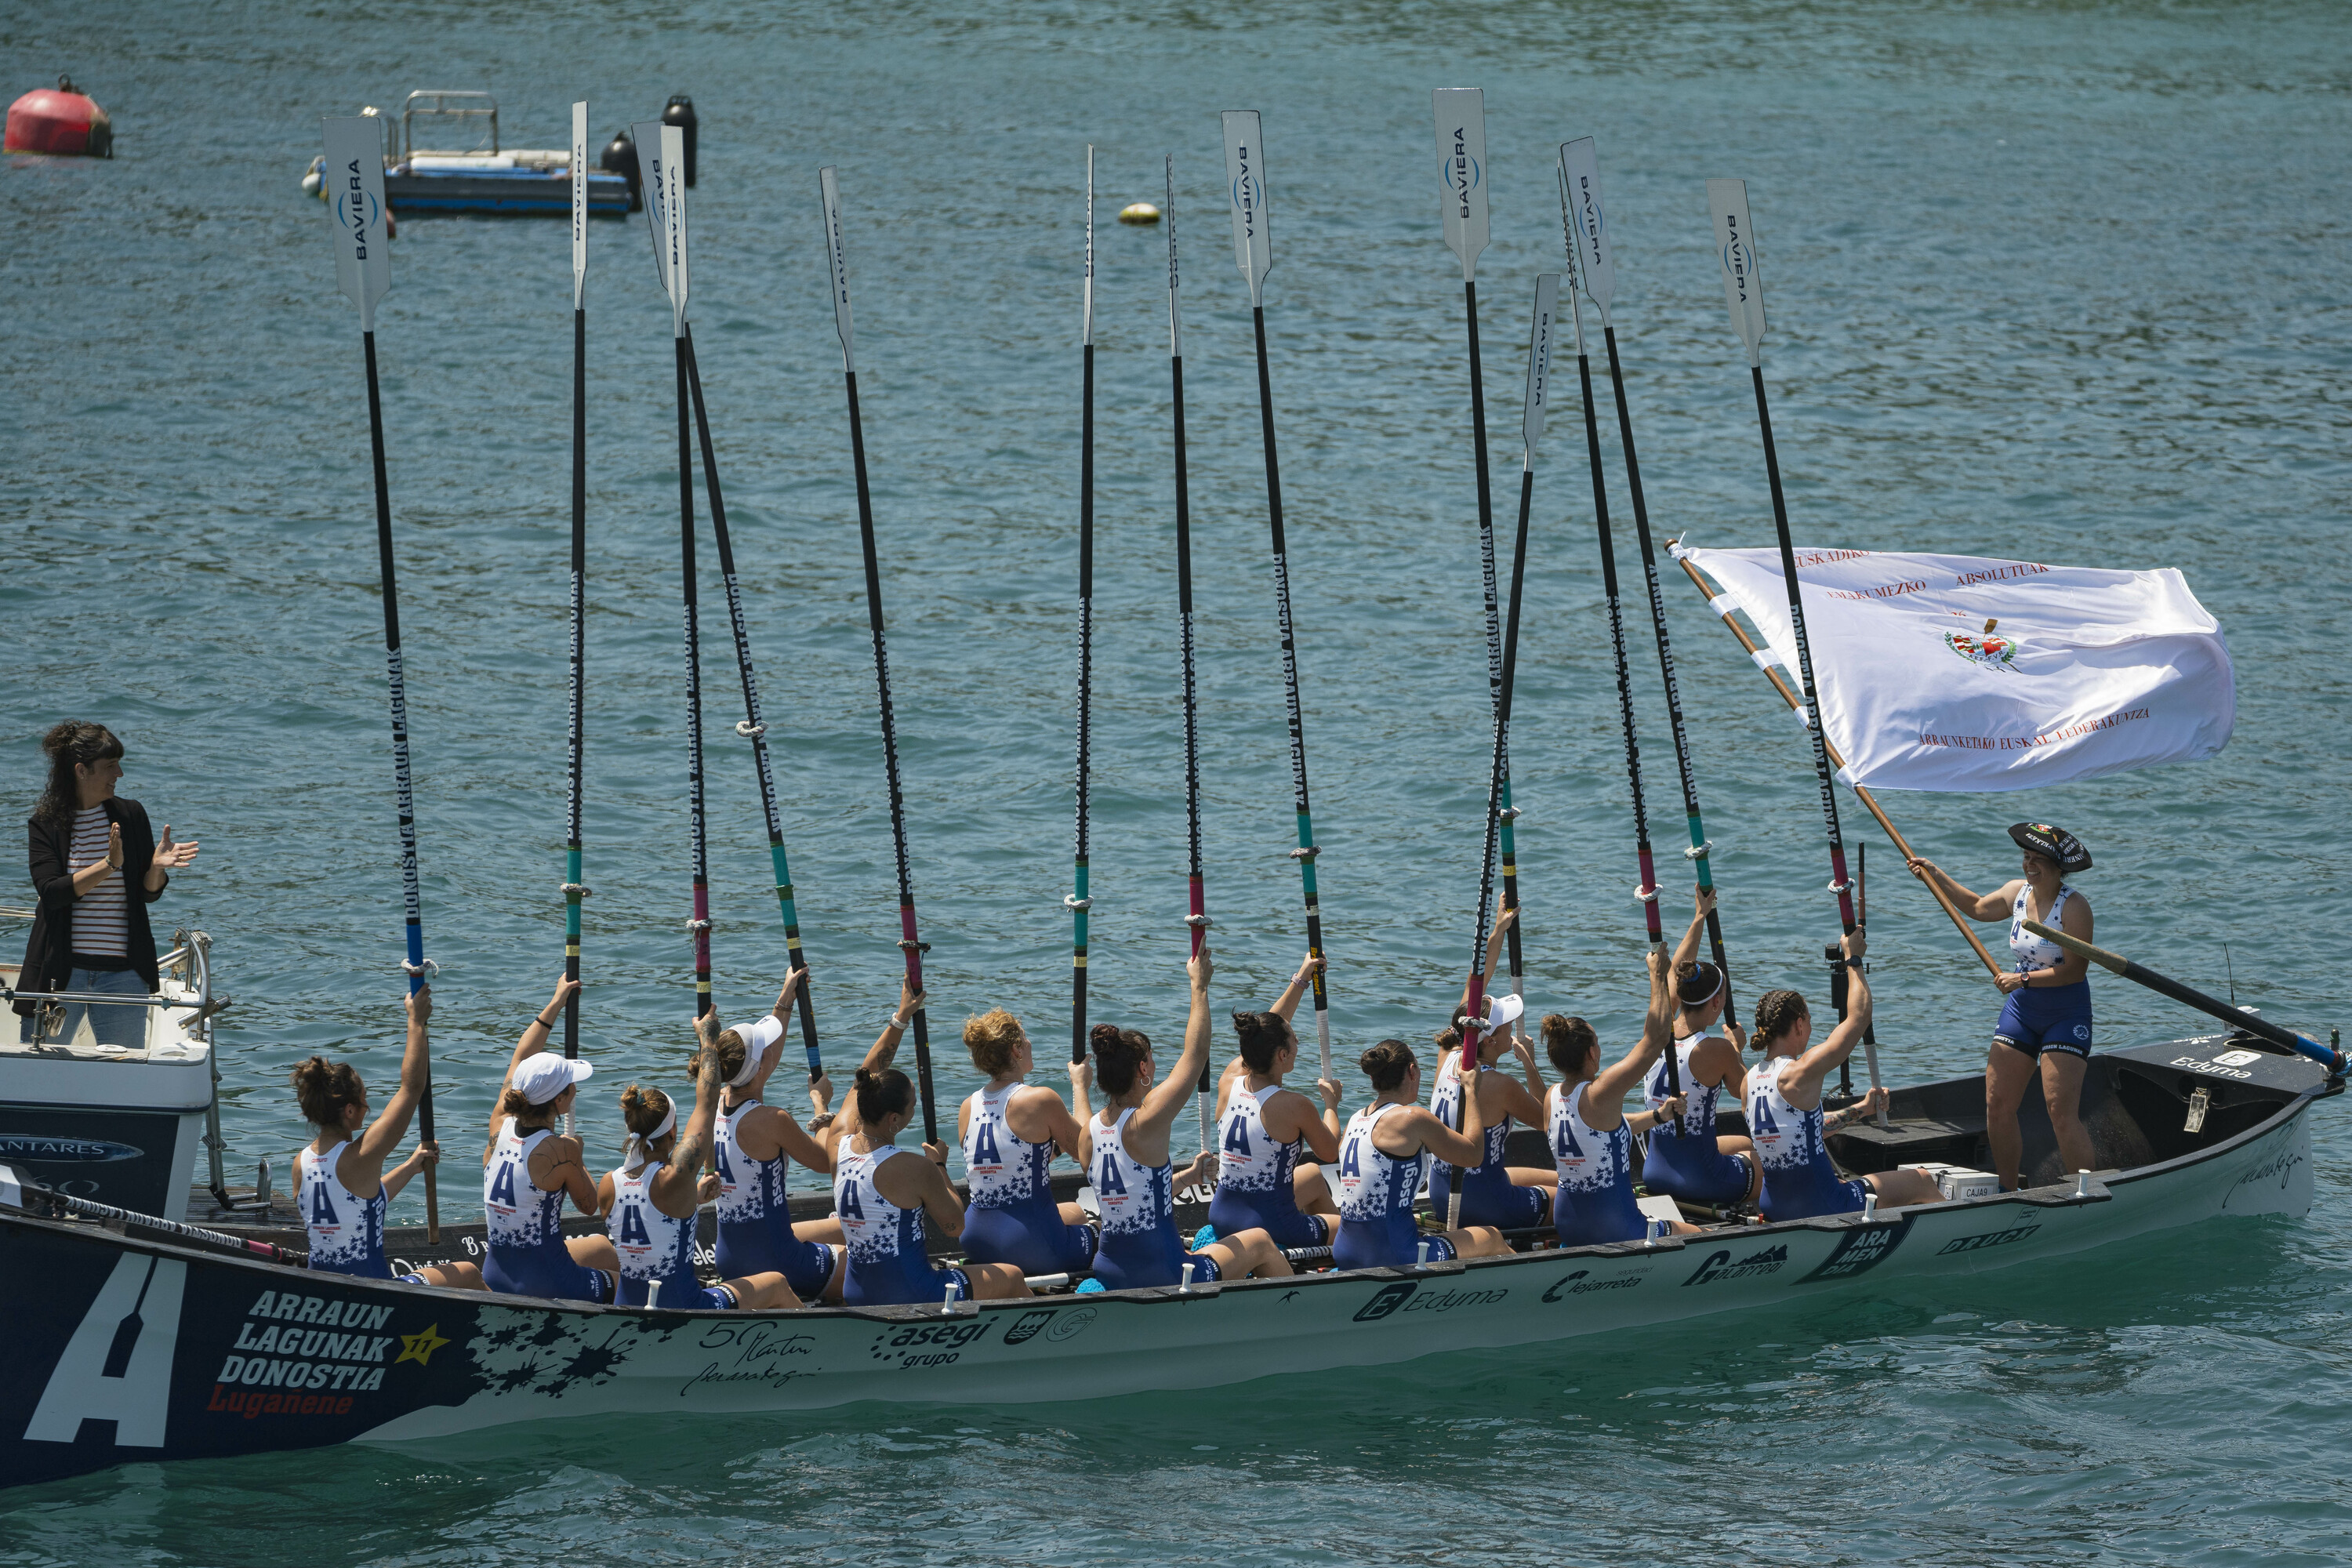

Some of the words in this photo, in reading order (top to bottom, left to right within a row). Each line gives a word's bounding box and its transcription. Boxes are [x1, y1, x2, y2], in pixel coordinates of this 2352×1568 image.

[574, 143, 583, 241] BAVIERA
[1239, 146, 1253, 239] BAVIERA
[1454, 127, 1469, 219] BAVIERA
[350, 158, 367, 260] BAVIERA
[669, 165, 678, 266] BAVIERA
[1581, 176, 1601, 266] BAVIERA
[1727, 215, 1747, 303] BAVIERA
[1479, 524, 1497, 604] LAGUNAK
[1828, 580, 1926, 600] EMAKUMEZKO
[1956, 564, 2049, 586] ABSOLUTUAK
[1486, 609, 1501, 679] ARRAUN
[387, 647, 408, 735] LAGUNAK
[1919, 734, 1994, 750] ARRAUNKETAKO
[2000, 734, 2052, 750] EUSKAL
[2056, 707, 2151, 741] FEDERAKUNTZA
[393, 741, 413, 818] ARRAUN
[399, 822, 419, 920] DONOSTIA
[2170, 1057, 2252, 1079] Edyma
[1225, 1115, 1252, 1156] A
[1754, 1095, 1780, 1135] A
[1809, 1111, 1824, 1156] asegi
[0, 1141, 105, 1155] NTARES
[510, 1138, 526, 1146] amura
[973, 1123, 1002, 1165] A
[1341, 1138, 1360, 1178] A
[1487, 1122, 1506, 1166] asegi
[1558, 1120, 1584, 1158] A
[1615, 1125, 1630, 1174] asegi
[489, 1160, 517, 1207] A
[768, 1158, 783, 1207] asegi
[1101, 1153, 1127, 1196] A
[1284, 1142, 1301, 1184] asegi
[312, 1181, 339, 1225] A
[840, 1179, 866, 1220] A
[1157, 1166, 1172, 1217] asegi
[1398, 1162, 1416, 1208] asegi
[1966, 1188, 1987, 1197] CAJA9
[372, 1196, 385, 1248] asegi
[550, 1189, 564, 1236] asegi
[621, 1205, 652, 1246] A
[1288, 1245, 1333, 1260] ARRAU
[1836, 1247, 1886, 1265] MEN
[1850, 1229, 1891, 1249] ARA
[1943, 1225, 2034, 1253] DRUCK
[1820, 1264, 1856, 1276] DIA
[249, 1290, 394, 1330] ARRAUN
[1403, 1288, 1509, 1312] Edyma
[233, 1322, 394, 1362] LAGUNAK
[409, 1338, 433, 1353] 11
[890, 1316, 1000, 1349] asegi
[216, 1355, 387, 1391] DONOSTIA
[900, 1351, 960, 1370] grupo
[207, 1384, 354, 1419] Lugañene
